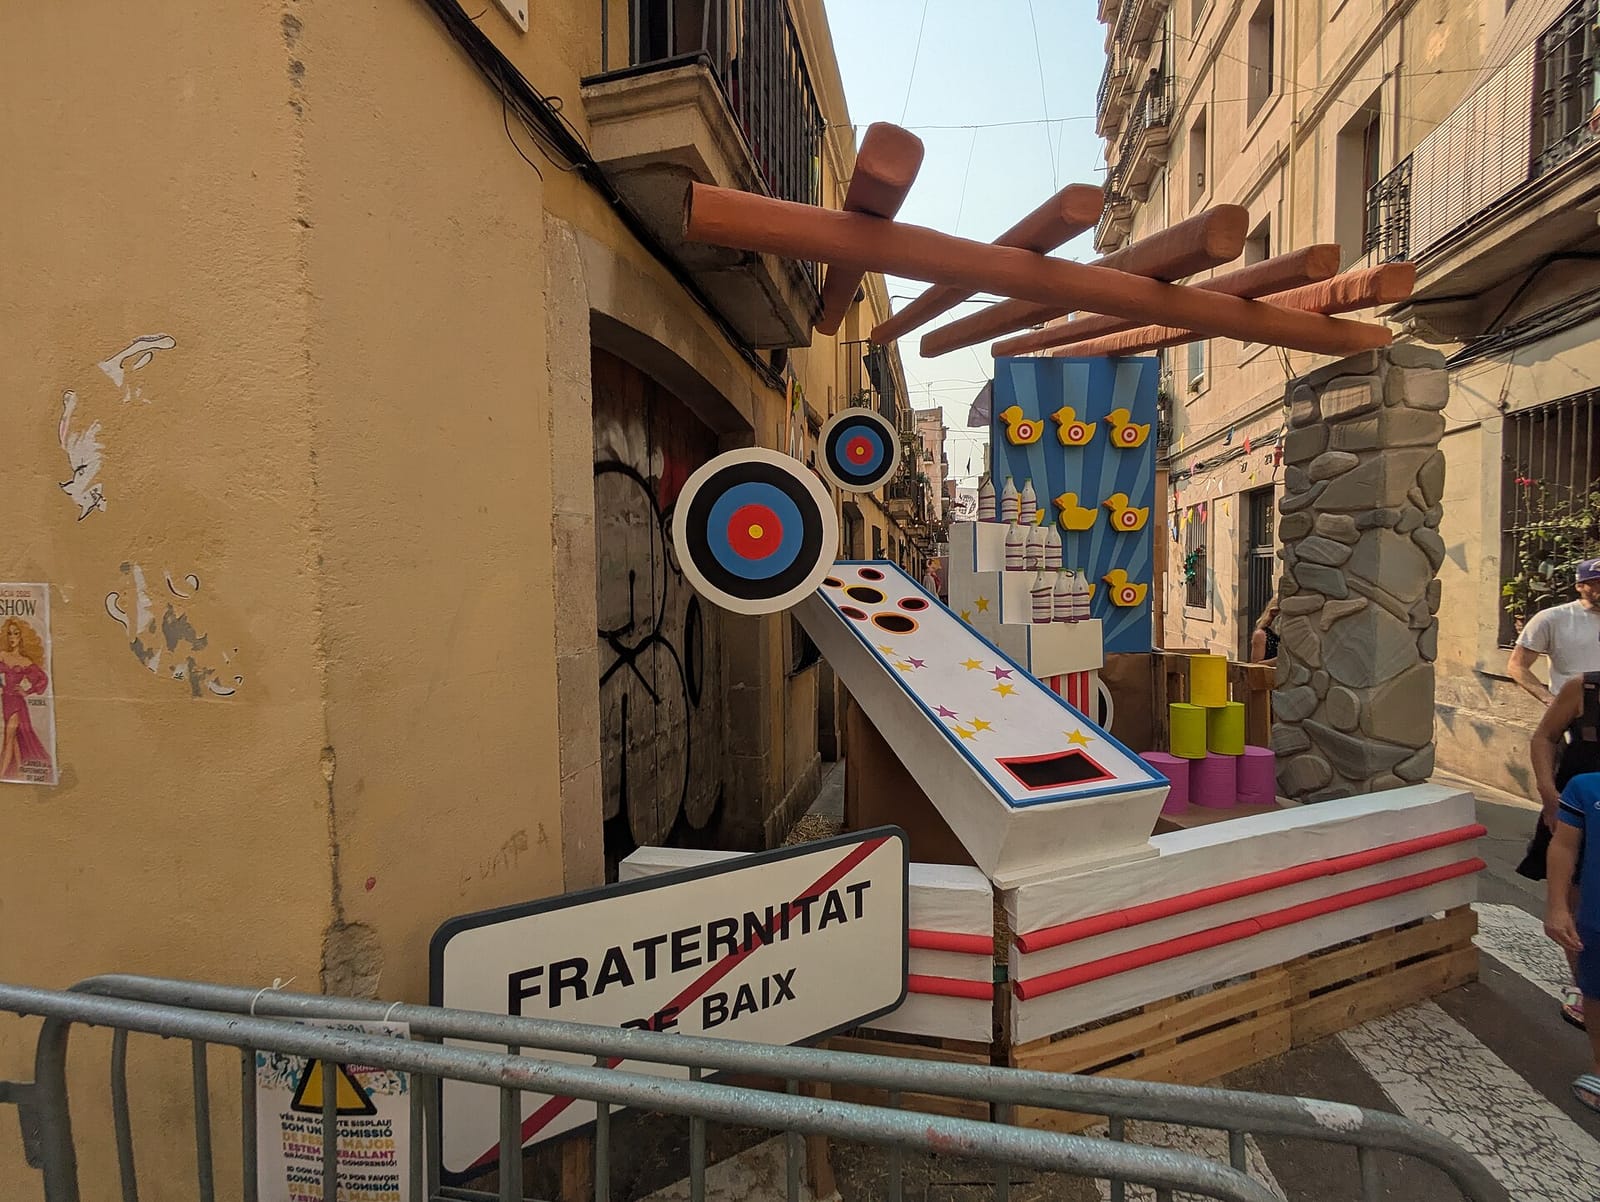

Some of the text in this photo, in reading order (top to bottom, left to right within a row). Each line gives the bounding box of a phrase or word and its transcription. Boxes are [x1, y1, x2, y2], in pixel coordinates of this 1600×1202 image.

[509, 880, 872, 1016] FRATERNITAT
[702, 967, 797, 1031] BAIX
[281, 1122, 305, 1132] SOM
[307, 1125, 322, 1135] UN
[288, 1143, 321, 1155] ESTEM
[336, 1150, 396, 1159] EBALLANT
[342, 1139, 395, 1150] MAJOR
[287, 1174, 321, 1186] SOMOS
[345, 1181, 400, 1191] COMISIÓN
